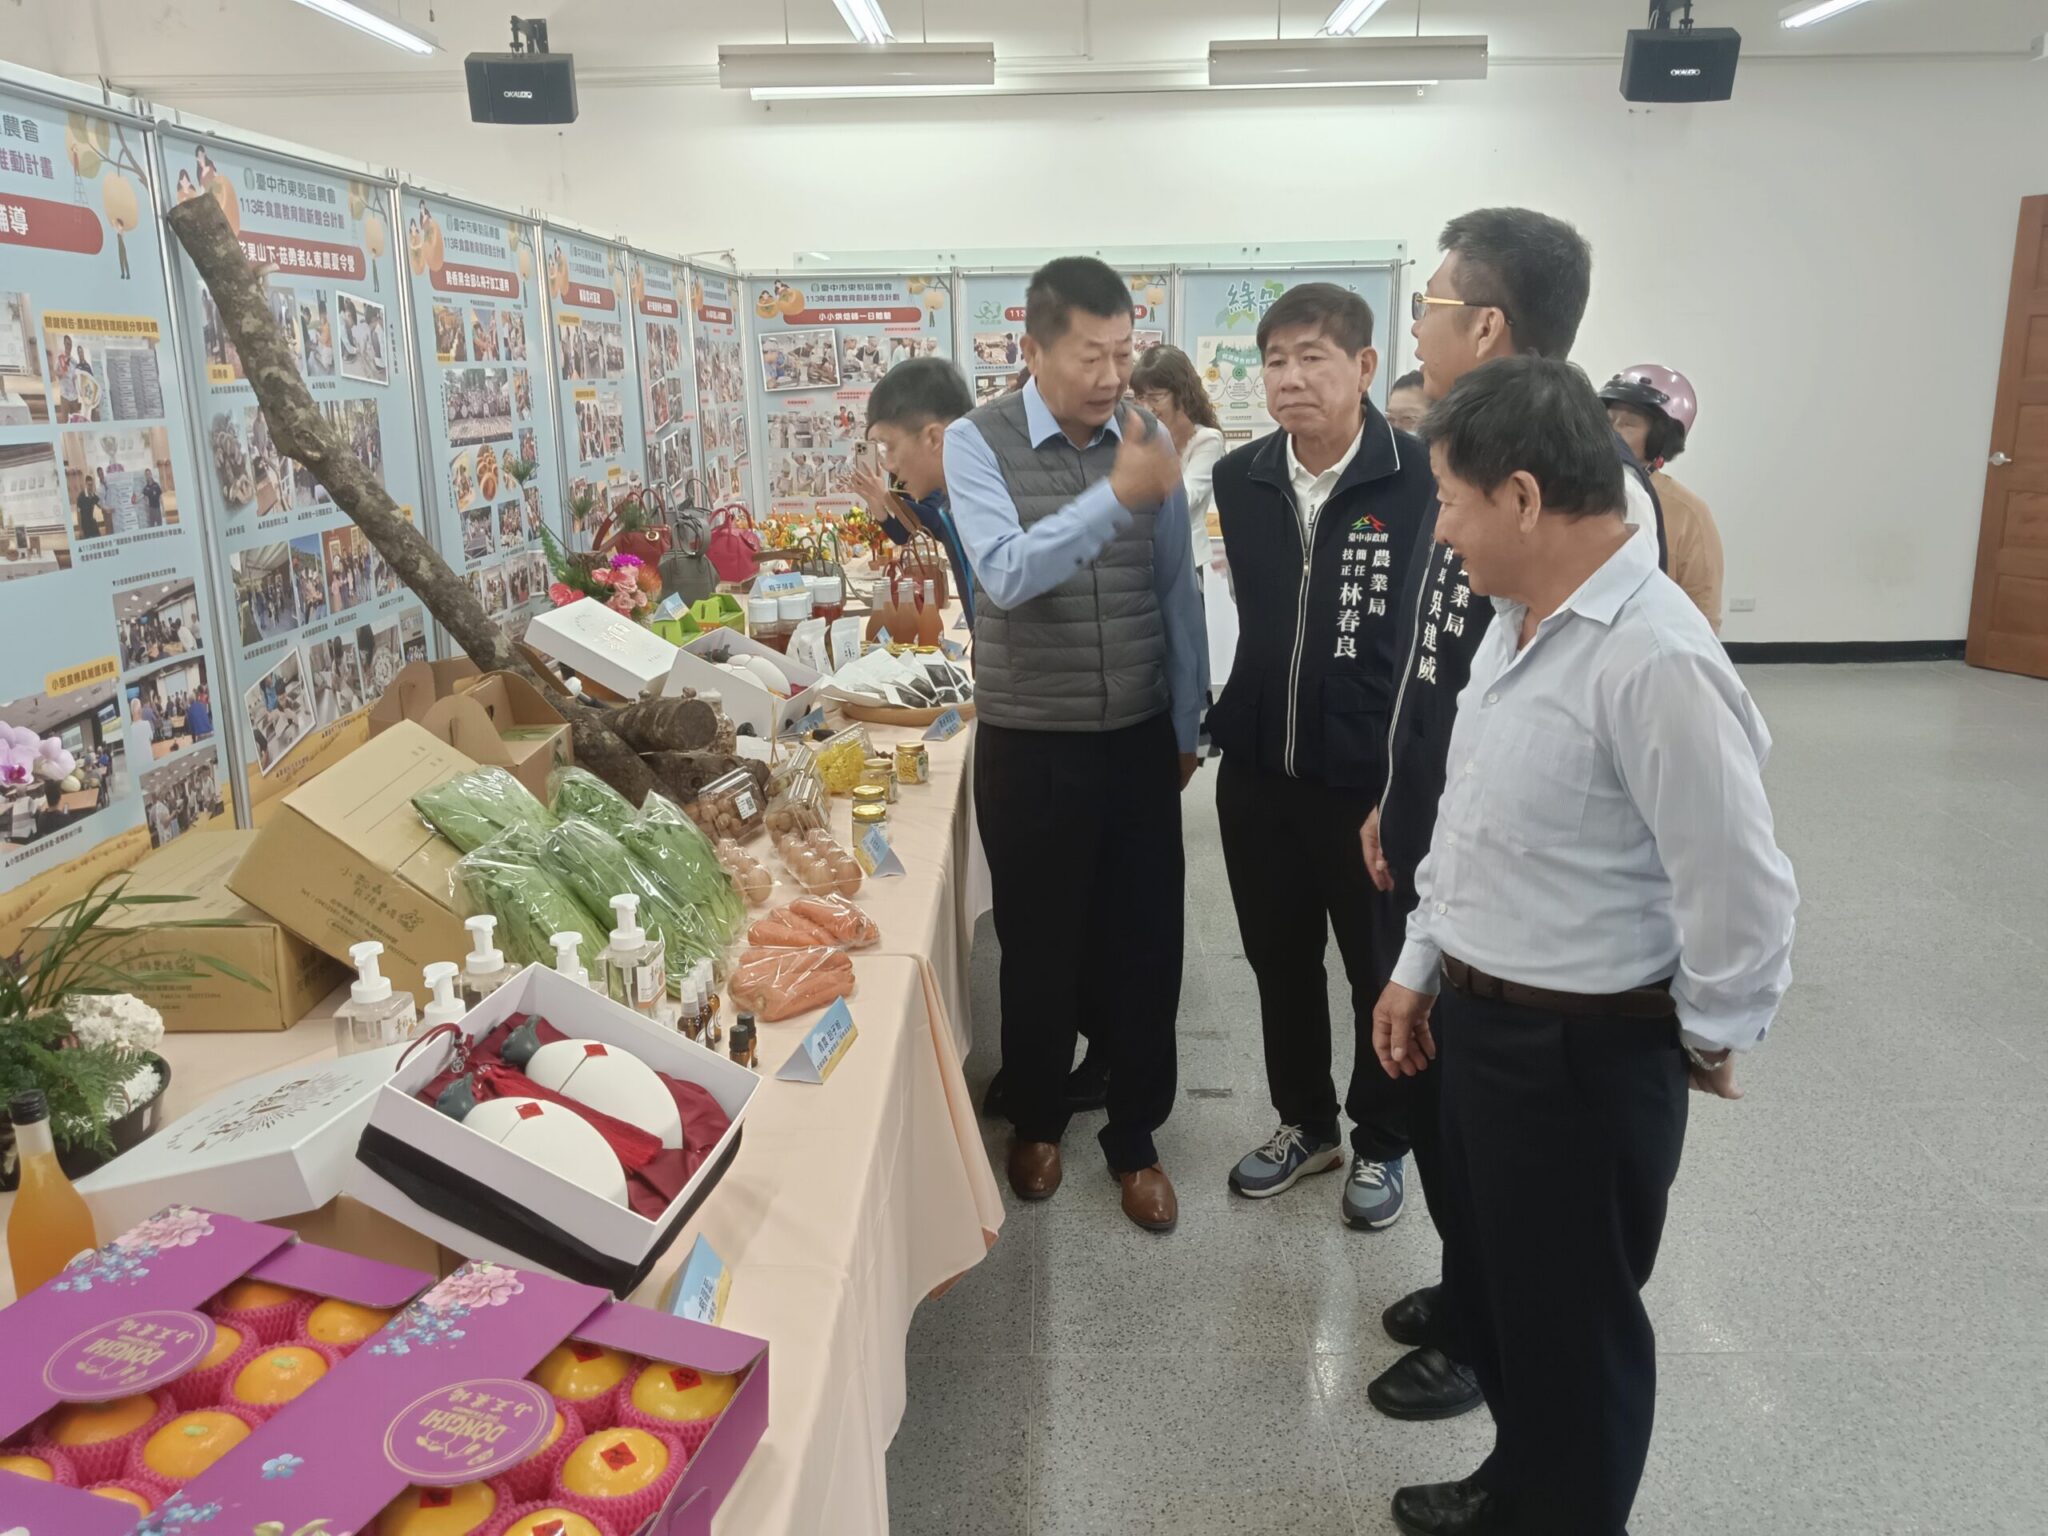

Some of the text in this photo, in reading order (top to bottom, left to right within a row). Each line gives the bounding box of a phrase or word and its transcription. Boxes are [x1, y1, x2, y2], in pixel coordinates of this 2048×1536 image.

[1348, 533, 1389, 543] 臺中市政府
[1367, 549, 1391, 617] 農業局
[1333, 581, 1363, 659] 林春良
[82, 1337, 166, 1366] DONGSHI
[419, 1408, 508, 1444] DONGSHI
